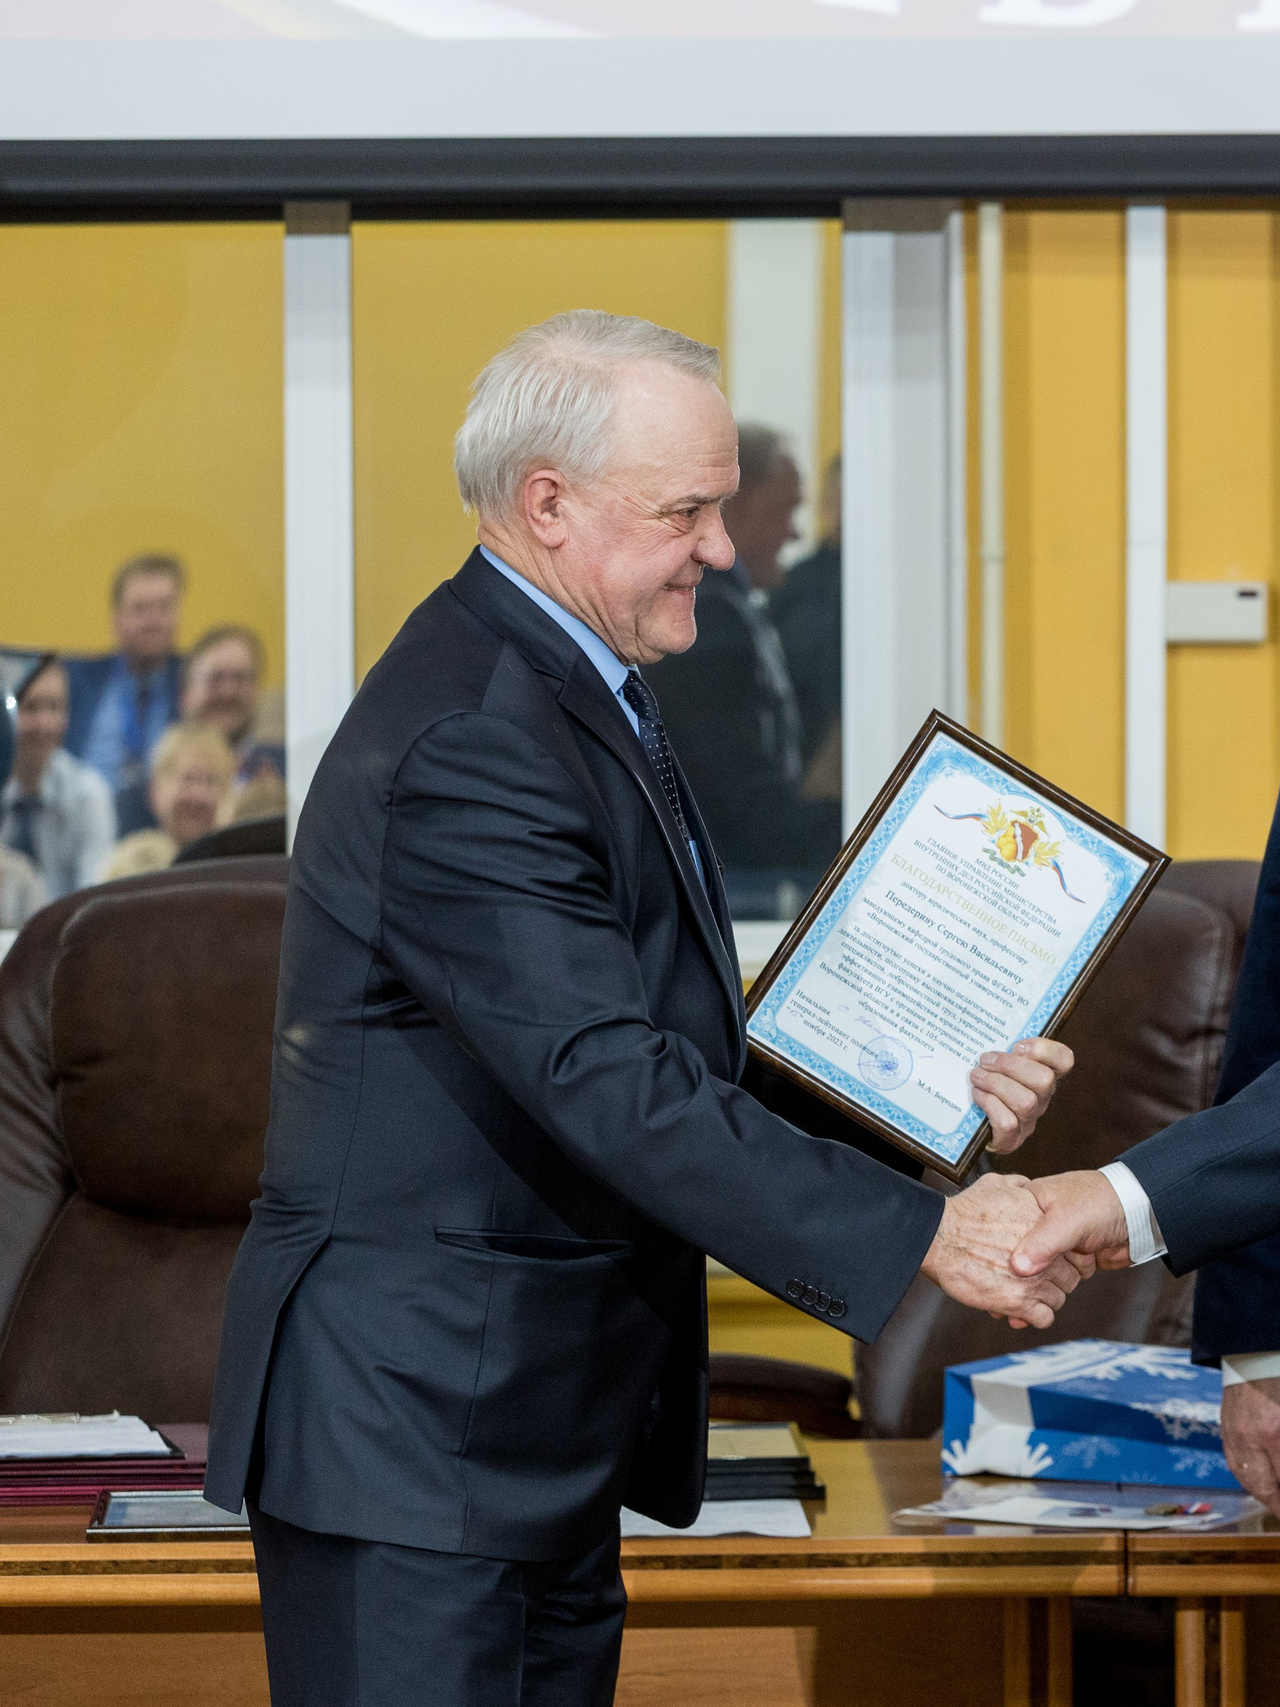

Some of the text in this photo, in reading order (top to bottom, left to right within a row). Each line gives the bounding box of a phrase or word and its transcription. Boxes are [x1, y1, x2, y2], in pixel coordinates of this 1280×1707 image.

[890, 853, 1057, 964] БЛАГОДАРСТВЕННОЕ ПИСЬМО
[913, 839, 1061, 938] ВНУТРЕННИХ ДЕЛ РОССИЙСКОЙ ФЕДЕРАЦИИ
[926, 837, 1056, 925] ГЛАВНОЕ УПРАВЛЕНИЕ МИНИСТЕРСТВА
[945, 871, 998, 907] ВОРОНЕЖСКОЙ
[997, 904, 1029, 928] ОБЛАСТИ
[974, 857, 1019, 889] МВД РОССИИ
[861, 896, 906, 928] заведующему
[906, 925, 938, 948] кафедрой
[938, 946, 971, 969] трудового
[971, 967, 990, 982] права
[991, 979, 1017, 997] ФГБОУ
[866, 911, 1013, 1008] «Воронежский государственный университет»
[884, 889, 1023, 984] Передерину Сергею Васильевичу
[900, 880, 1028, 965] доктору юридических наук, профессору
[789, 998, 850, 1040] генерал-лейтенант
[795, 989, 831, 1016] Начальник
[818, 961, 863, 993] Воронежской
[862, 991, 889, 1010] области
[900, 1015, 919, 1030] связи
[837, 927, 882, 960] деятельности,
[883, 957, 921, 984] подготовку
[920, 981, 1009, 1040] высококвалифицированных
[837, 961, 873, 988] факультета
[873, 984, 891, 997] ВГУ
[895, 1000, 926, 1022] органами
[925, 1020, 964, 1047] внутренних
[964, 1045, 978, 1055] дел
[840, 941, 996, 1044] специалистов, добросовестный труд, укрепление
[840, 953, 886, 985] эффективного
[938, 1016, 984, 1048] юридического
[859, 930, 902, 959] достигнутые
[901, 957, 926, 975] успехи
[931, 975, 1006, 1027] научно-педагогической
[802, 1018, 826, 1036] ноября
[825, 1032, 843, 1047] 2023
[857, 999, 898, 1028] образования
[898, 1025, 935, 1052] факультета
[933, 1090, 962, 1113] Бородин
